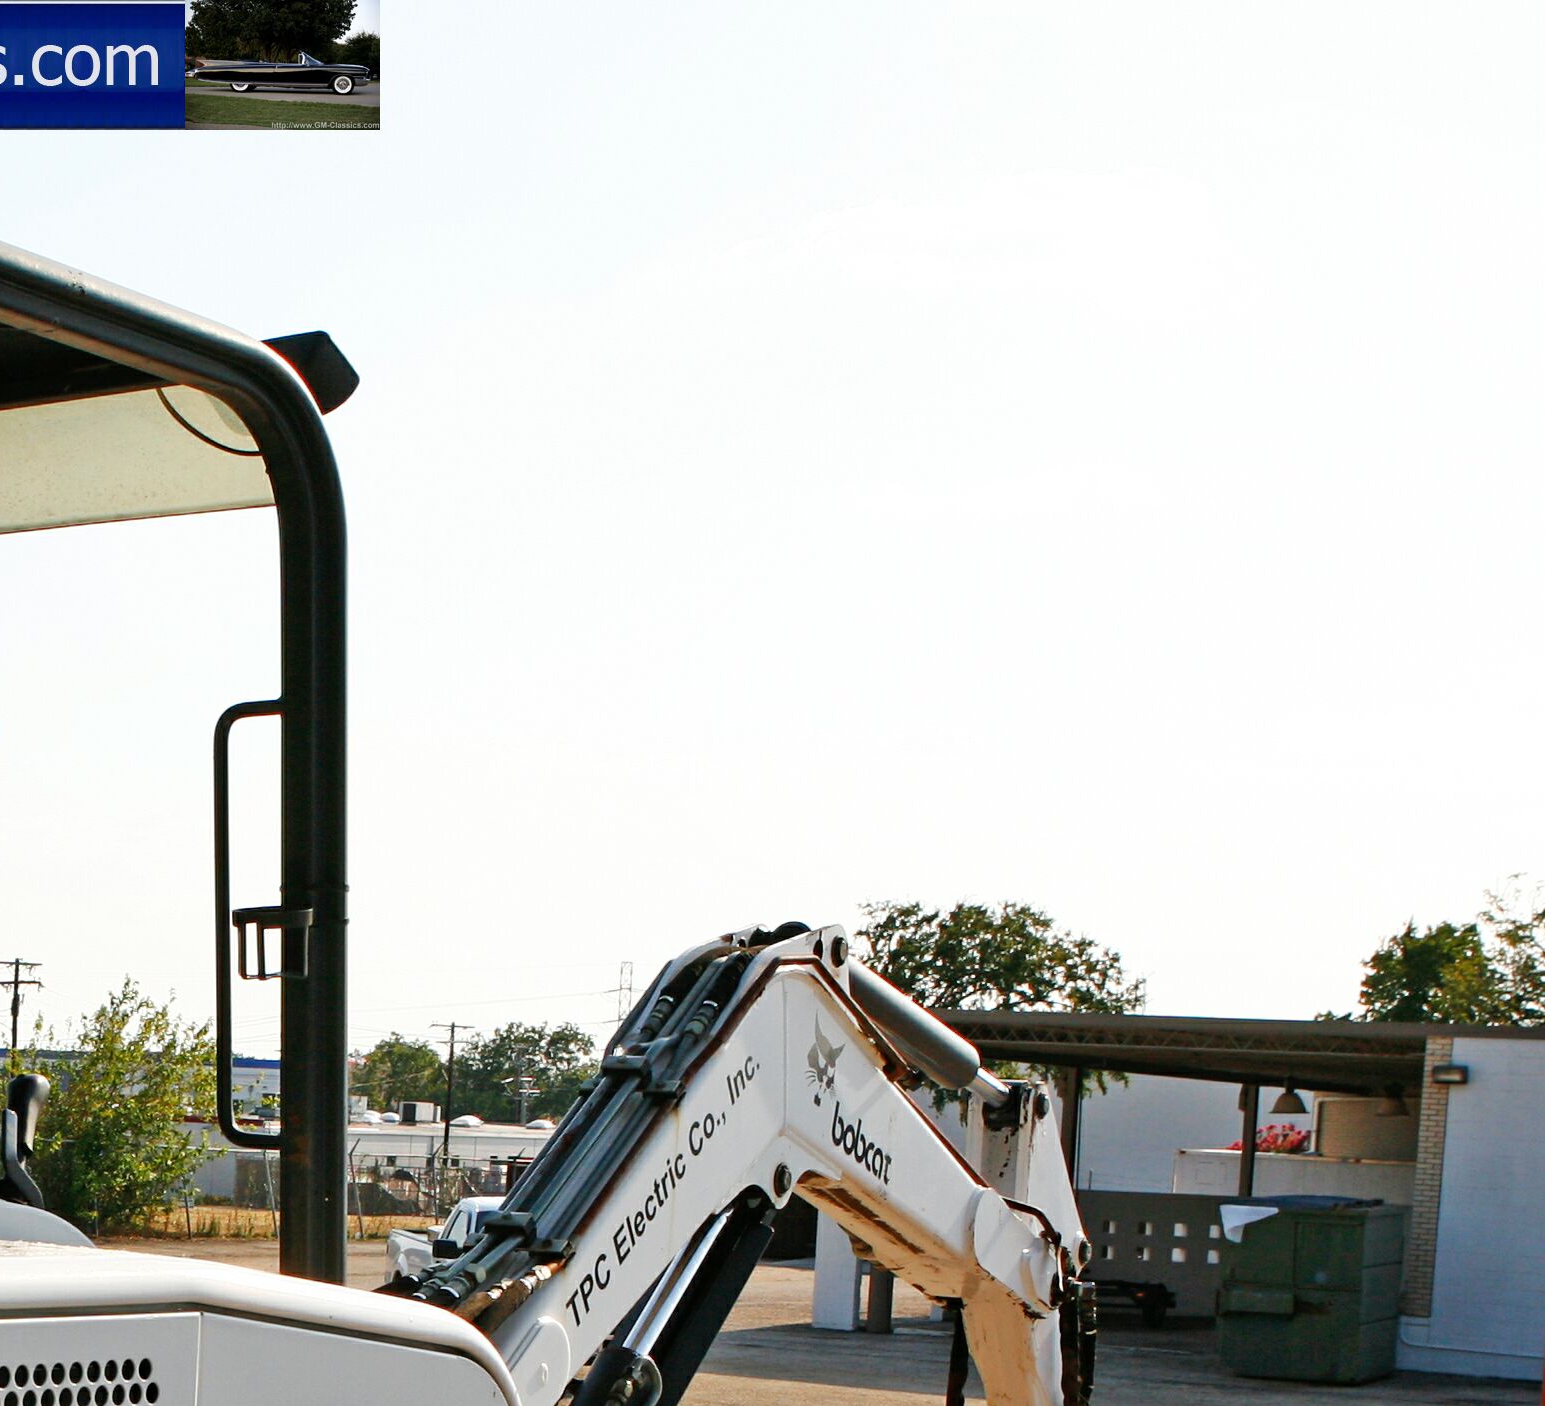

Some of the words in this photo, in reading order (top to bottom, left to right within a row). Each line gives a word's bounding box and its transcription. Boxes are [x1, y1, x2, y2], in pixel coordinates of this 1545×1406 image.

[565, 1253, 611, 1327] TPC
[612, 1152, 686, 1265] Electric
[688, 1111, 726, 1156] Co.,
[726, 1055, 760, 1105] Inc.
[831, 1100, 892, 1186] bobcat
